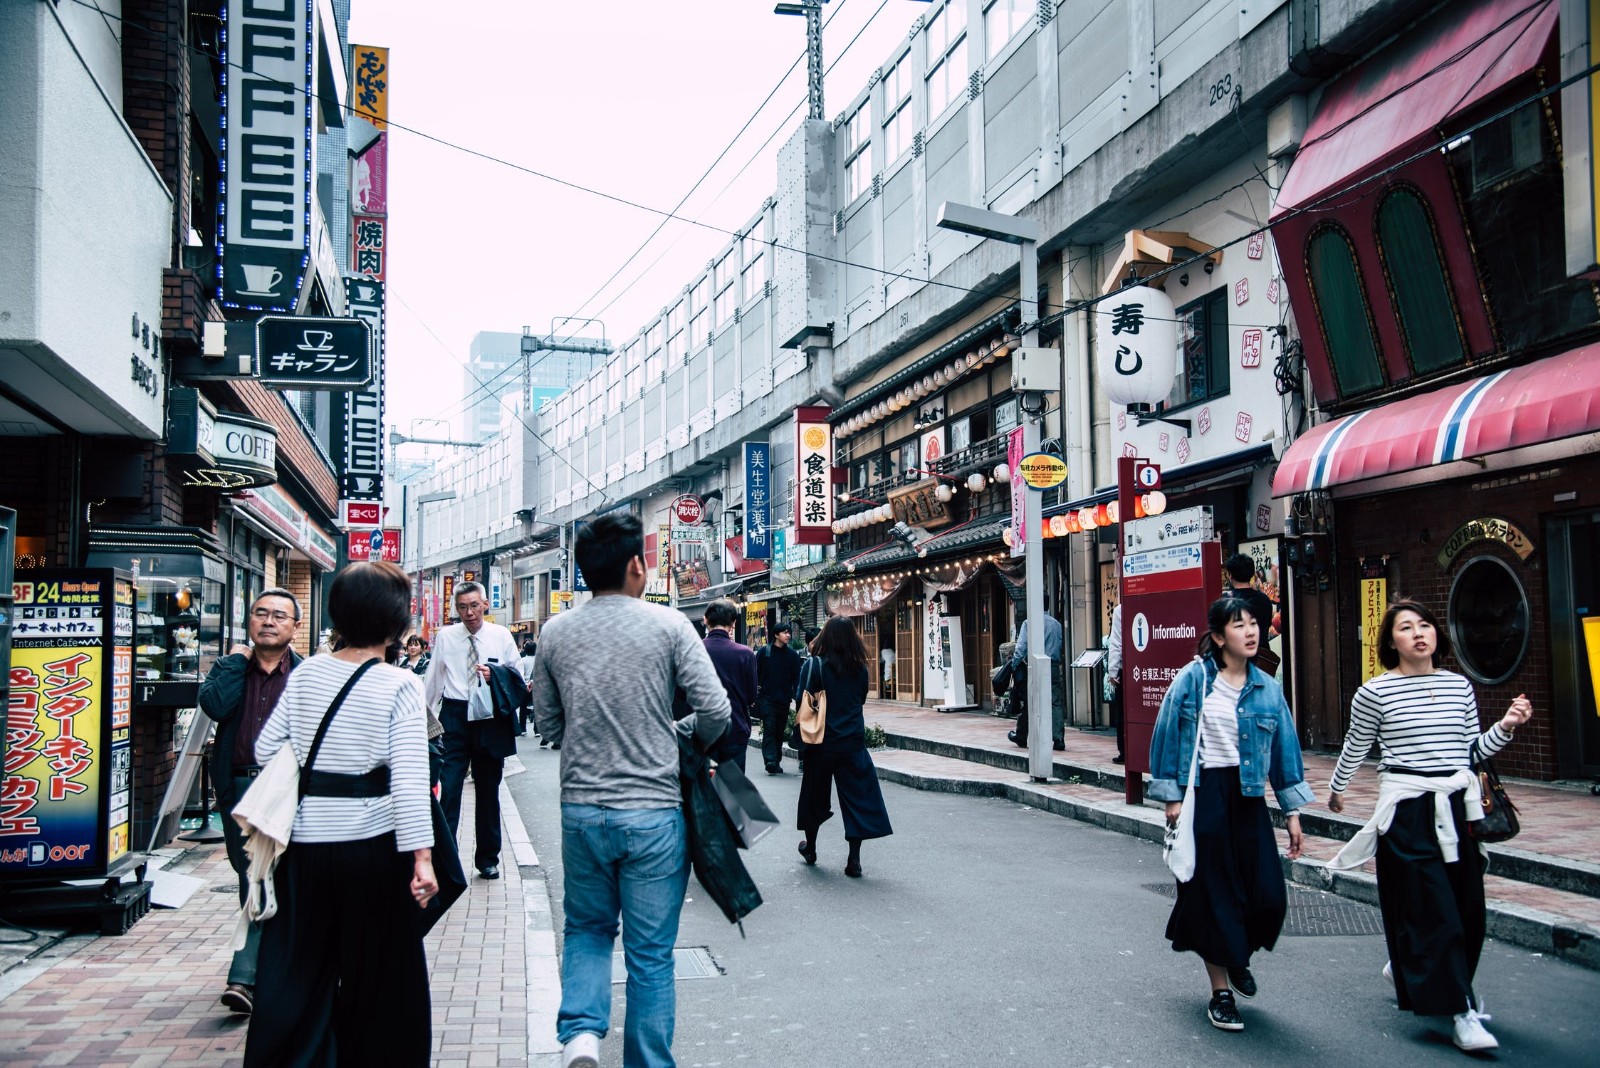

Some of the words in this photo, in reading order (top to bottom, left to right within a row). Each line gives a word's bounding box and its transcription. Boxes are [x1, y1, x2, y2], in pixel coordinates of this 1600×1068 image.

[1210, 73, 1232, 107] 263
[1111, 303, 1145, 376] 寿し
[270, 352, 360, 373] ギャラン
[804, 452, 827, 524] 食道楽
[350, 509, 377, 519] 宝くじ
[678, 506, 699, 517] 消火栓
[13, 585, 31, 602] 3F
[37, 582, 60, 604] 24
[62, 594, 100, 604] 時間営業
[12, 621, 96, 633] ターネットカフェ
[1152, 623, 1196, 639] Information
[13, 639, 55, 648] Internet
[56, 638, 78, 647] Cafe
[143, 686, 155, 702] F
[43, 652, 93, 801] インターネット
